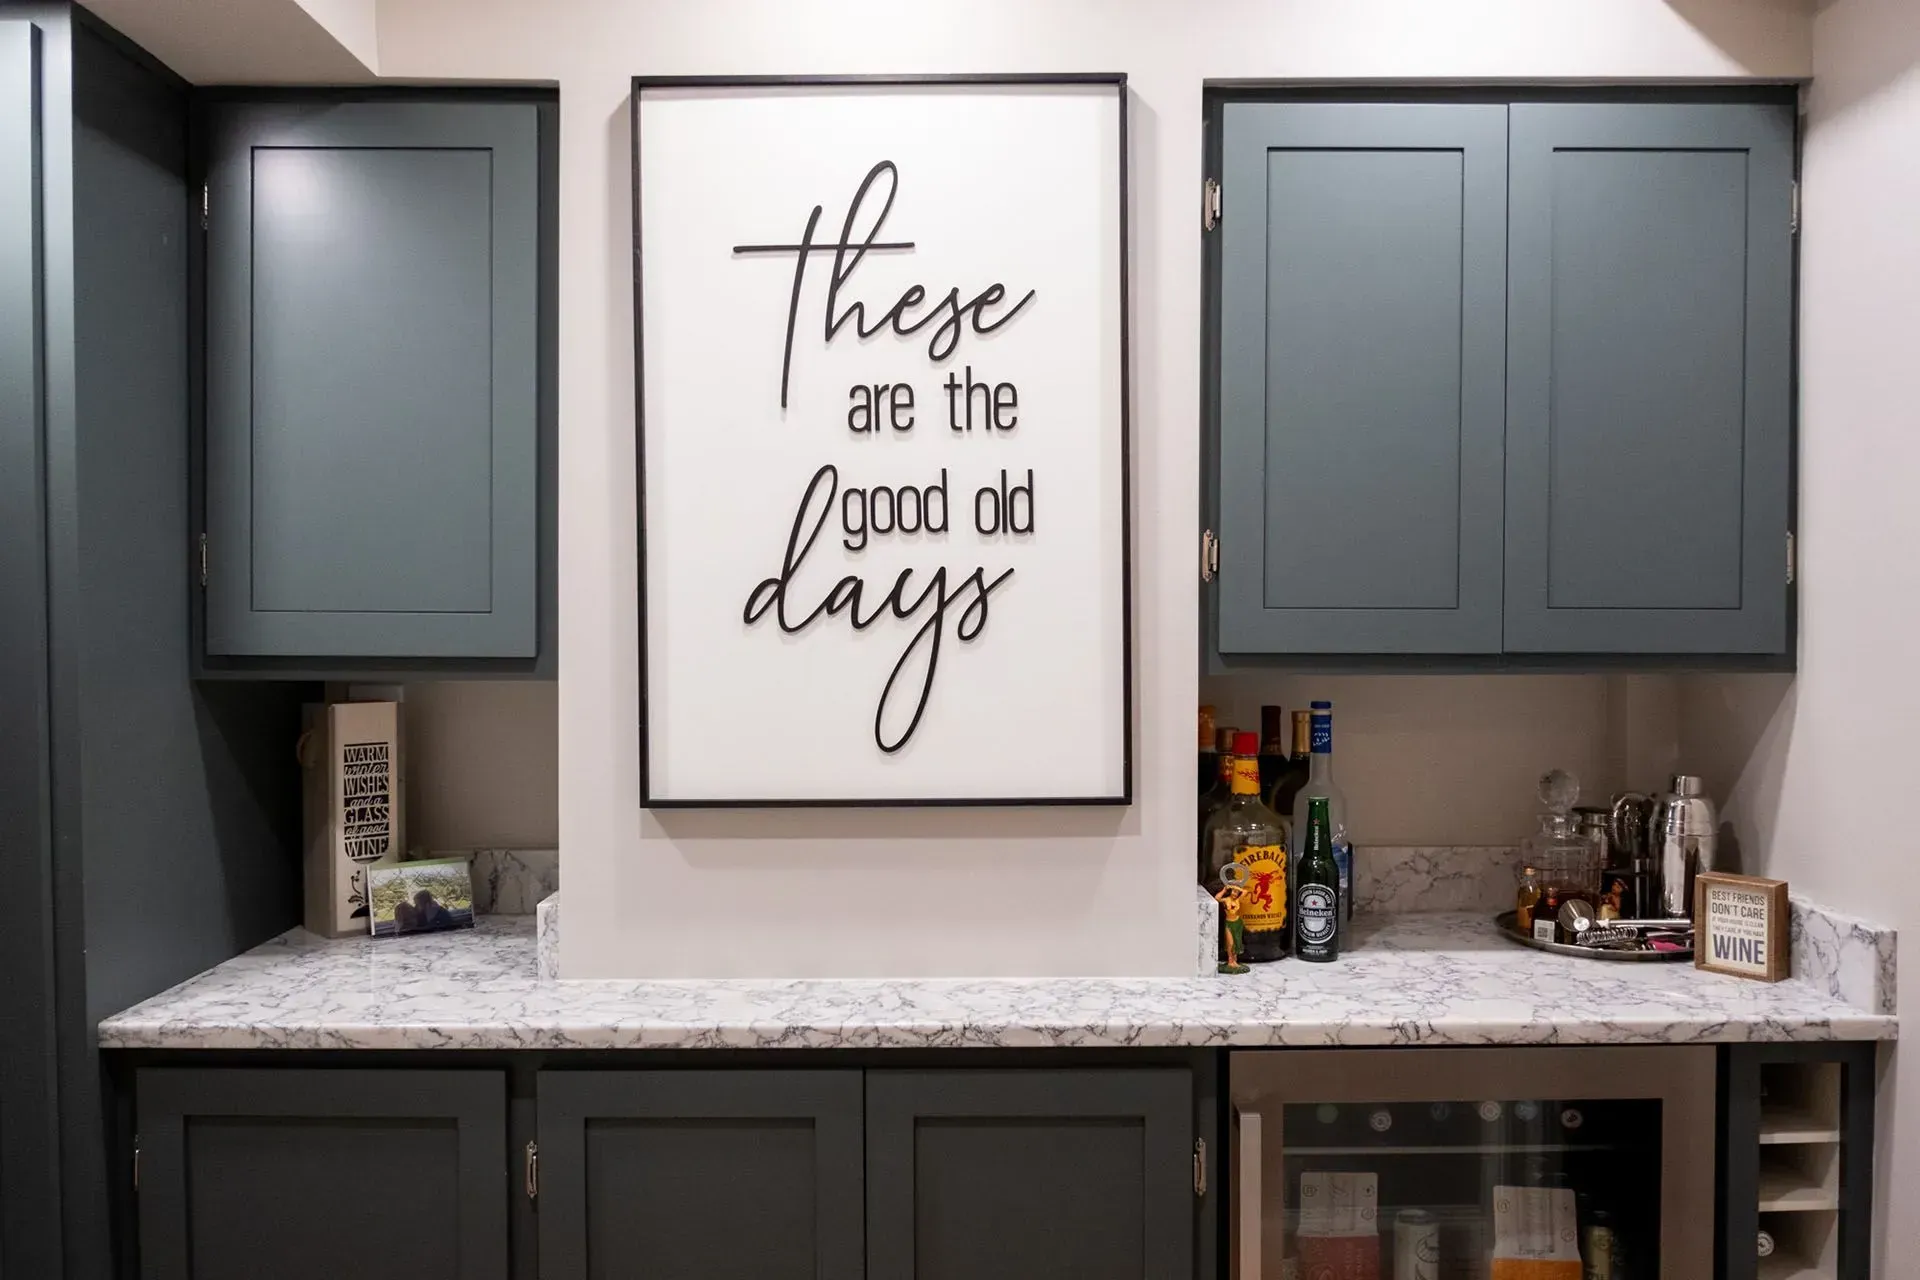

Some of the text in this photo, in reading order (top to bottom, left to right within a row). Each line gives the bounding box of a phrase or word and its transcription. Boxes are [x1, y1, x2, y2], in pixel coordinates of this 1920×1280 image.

[733, 159, 1036, 409] these
[847, 365, 1019, 432] are the
[841, 468, 1036, 552] good old
[743, 464, 1015, 754] days
[344, 745, 388, 763] WARM
[344, 761, 388, 776] winter
[344, 775, 388, 795] WISHES
[344, 806, 388, 824] GLASS
[345, 837, 388, 857] WINE
[1240, 850, 1284, 868] FIREBALL
[1712, 890, 1765, 906] BEST FRIENDS
[1299, 908, 1333, 917] Heineken
[1712, 902, 1765, 920] DON'T CARE
[1713, 934, 1765, 965] WINE
